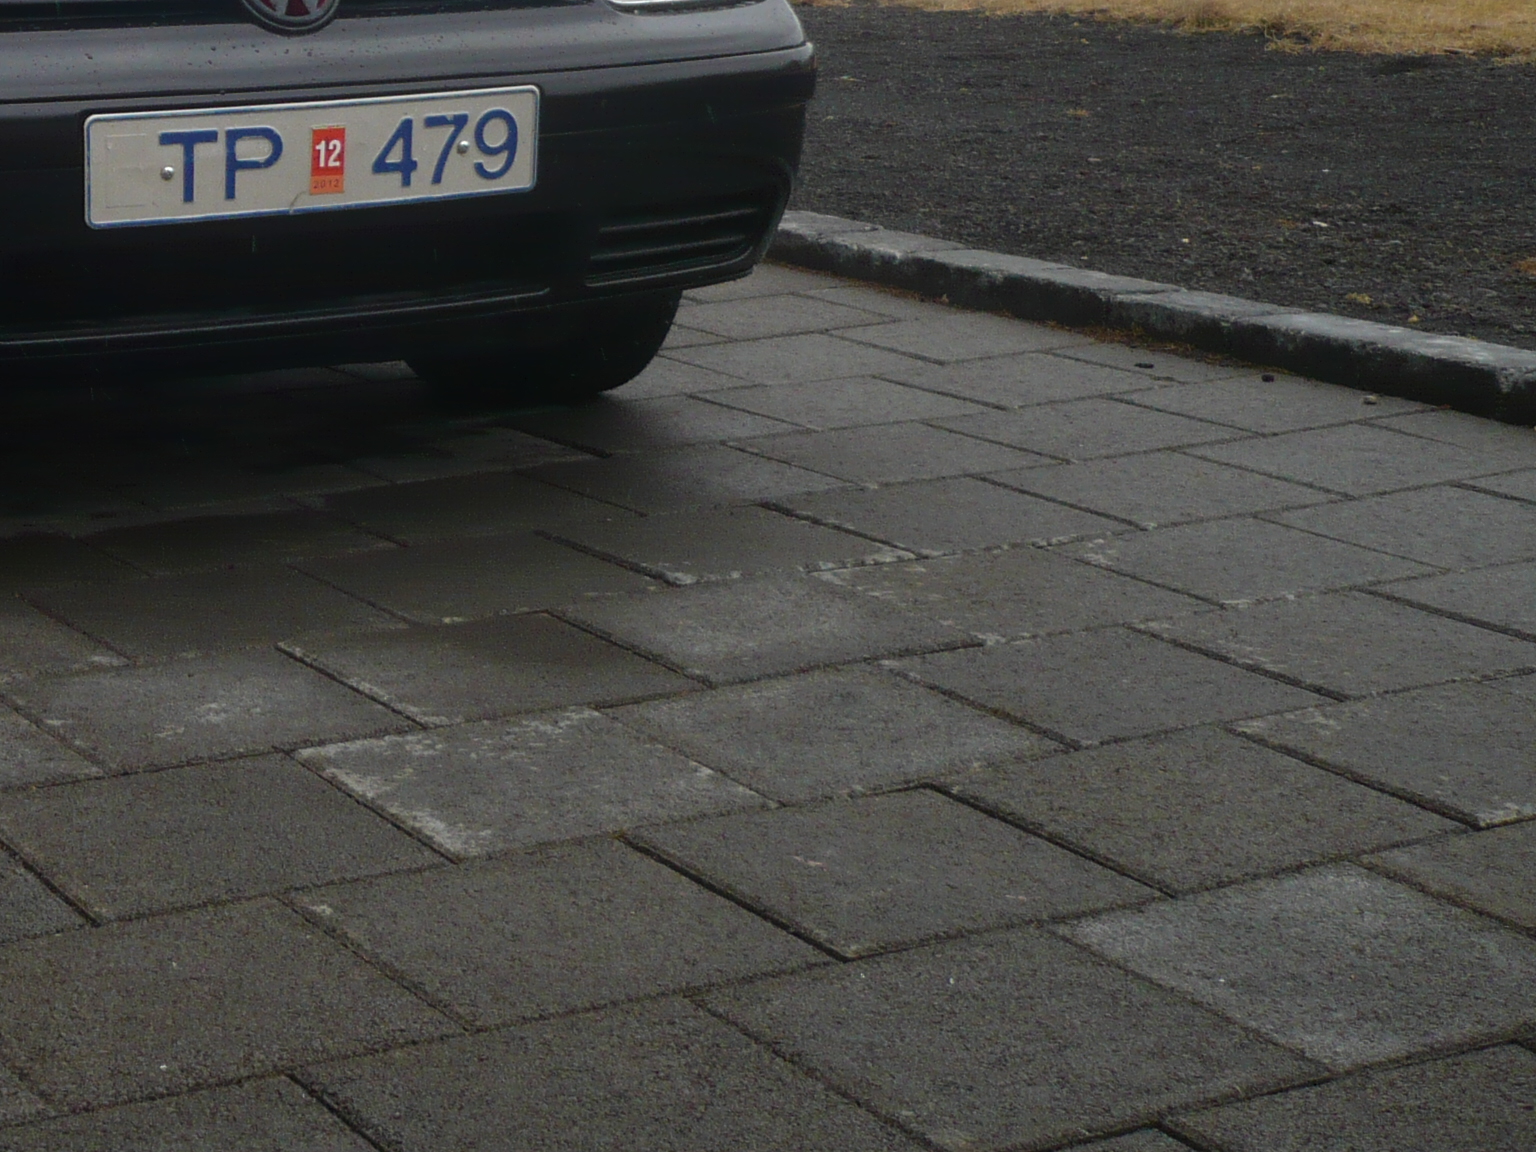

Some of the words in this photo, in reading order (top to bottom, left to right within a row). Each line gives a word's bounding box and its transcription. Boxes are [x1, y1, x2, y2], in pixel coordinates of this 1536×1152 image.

[158, 126, 284, 203] TP
[371, 107, 519, 188] 479
[315, 139, 342, 168] 12
[312, 178, 340, 190] 2012
